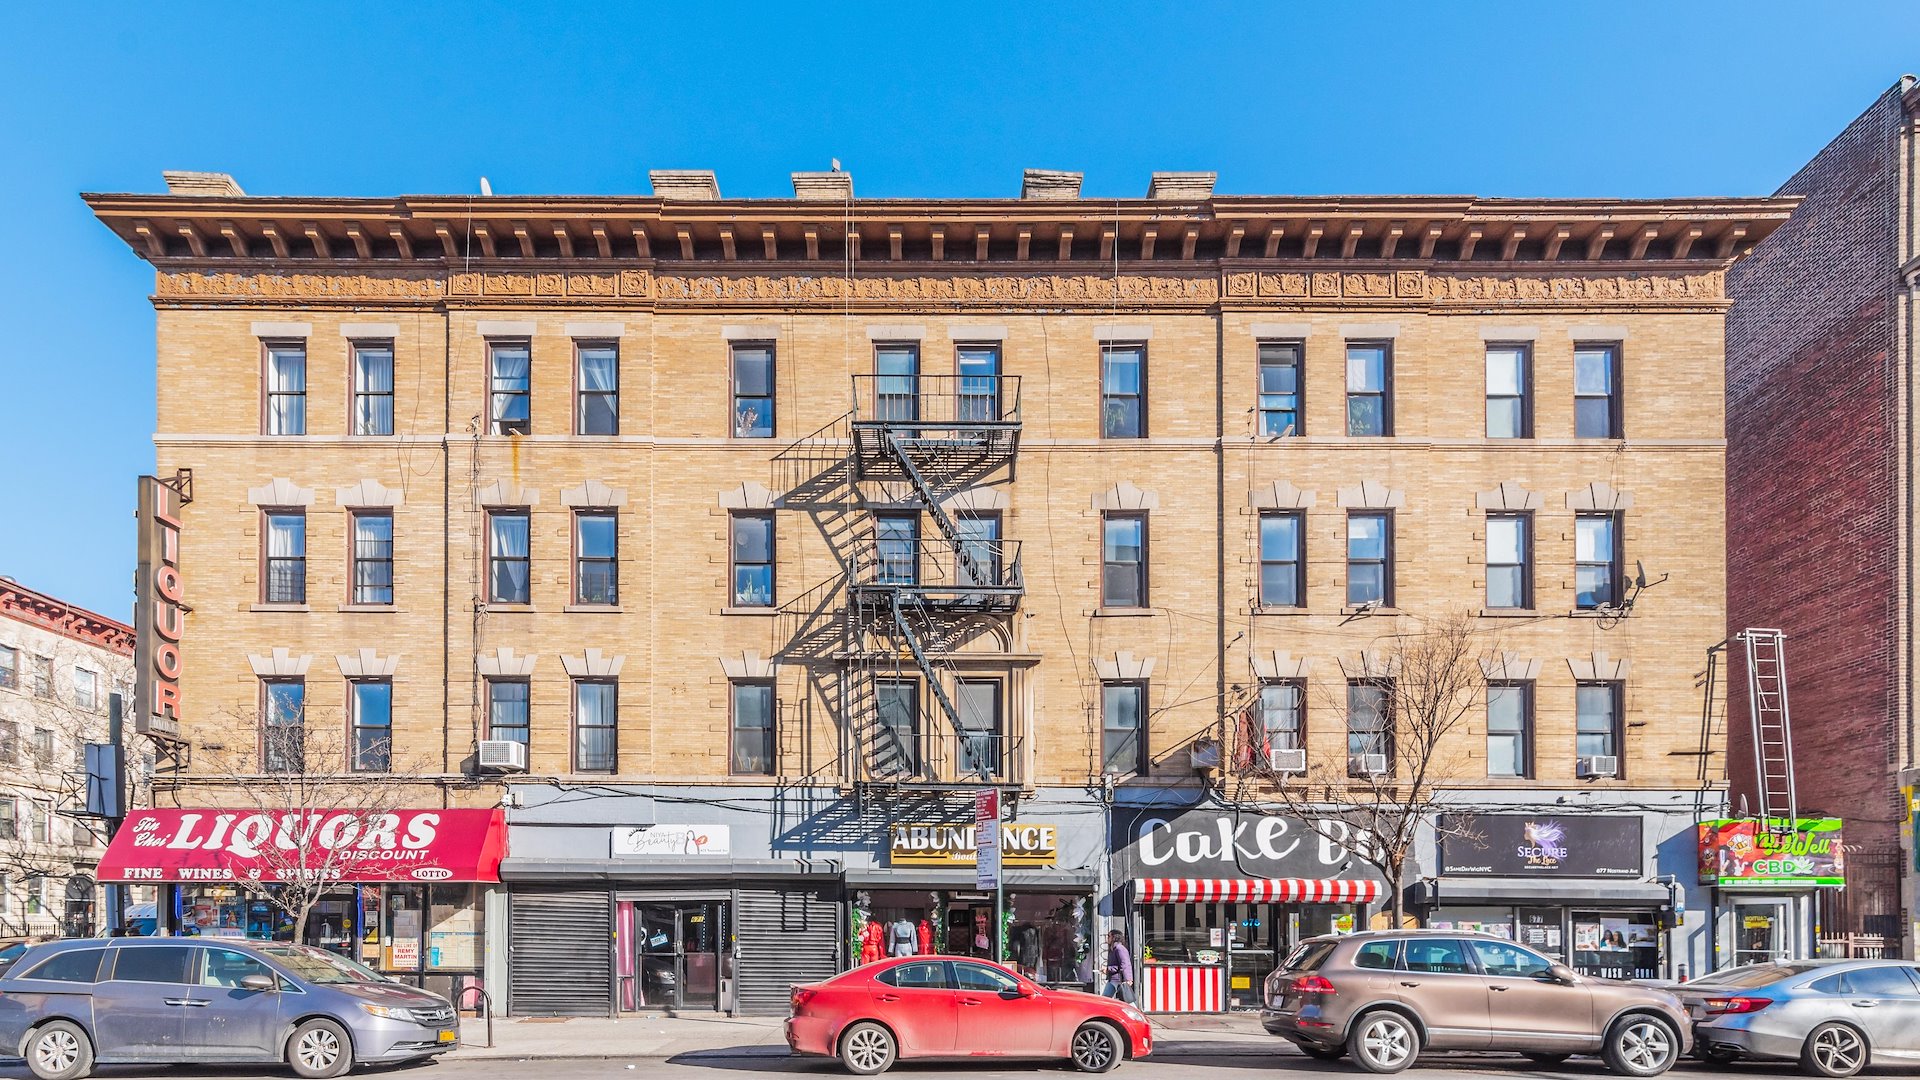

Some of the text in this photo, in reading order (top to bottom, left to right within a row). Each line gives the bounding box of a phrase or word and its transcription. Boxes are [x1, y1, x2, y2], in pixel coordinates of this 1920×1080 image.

[154, 484, 184, 719] LIQUOR
[166, 812, 440, 858] LIQUORS
[627, 831, 677, 852] Beauty
[893, 826, 1055, 850] ABUNNCE
[1139, 816, 1300, 866] Cake
[339, 850, 429, 860] DISCOUNT
[1517, 846, 1568, 858] SECURE
[123, 867, 163, 879] FINE
[178, 868, 232, 879] WINES
[248, 868, 261, 879] &
[416, 870, 448, 878] LOTTO
[1753, 860, 1796, 874] CBD
[1600, 967, 1623, 978] WASH
